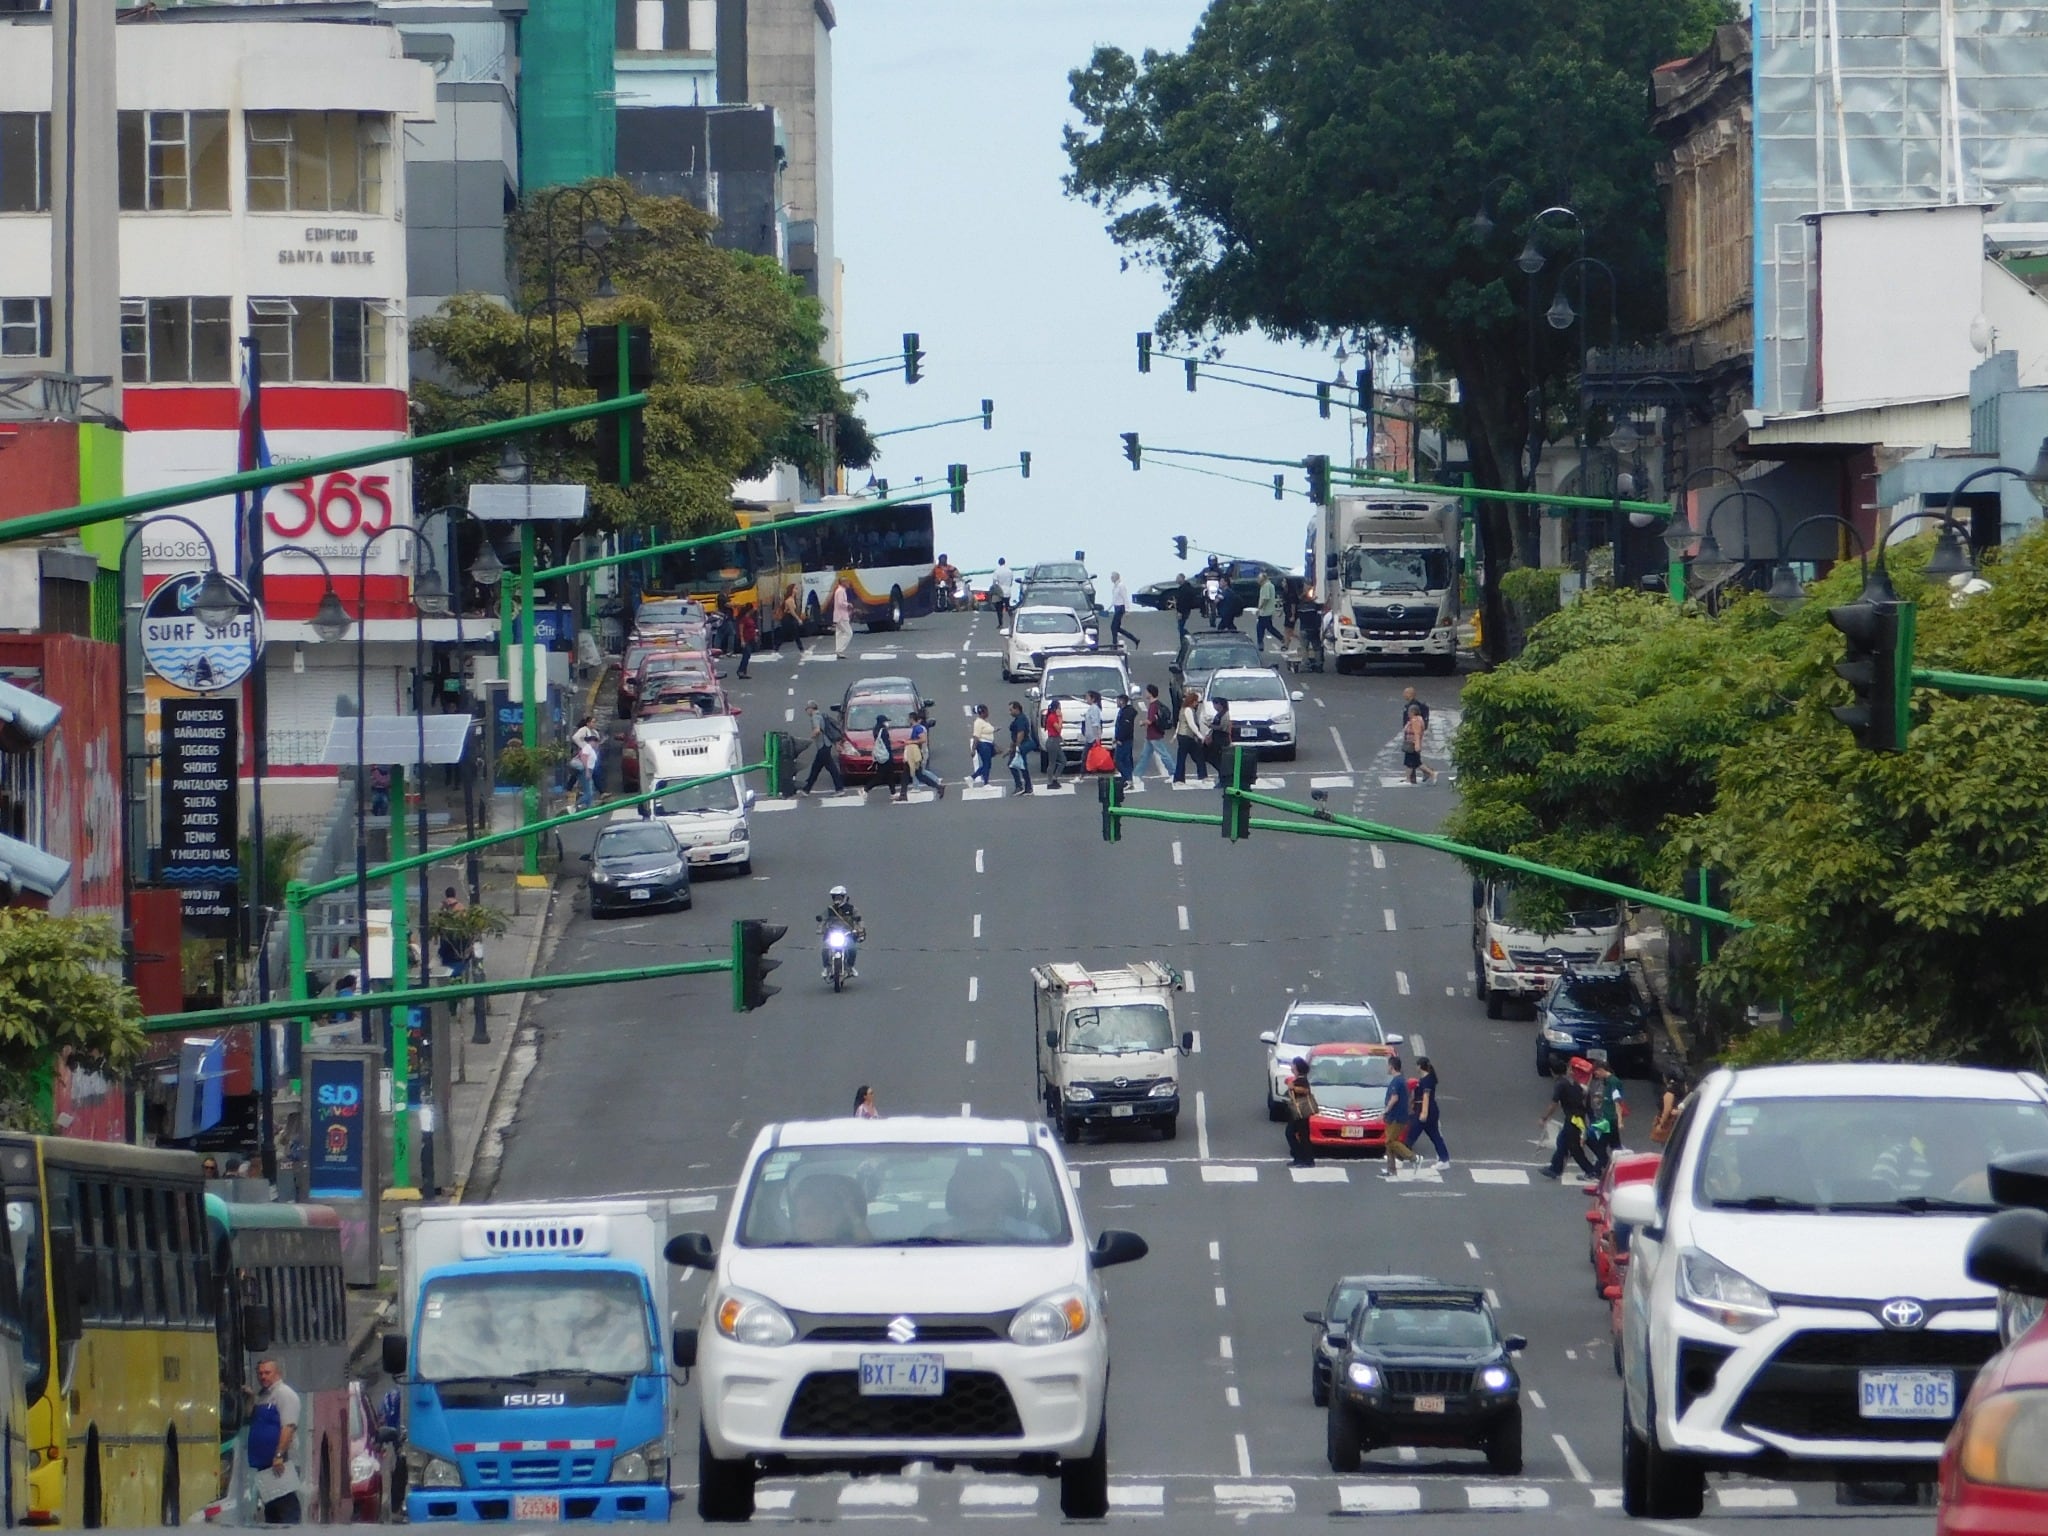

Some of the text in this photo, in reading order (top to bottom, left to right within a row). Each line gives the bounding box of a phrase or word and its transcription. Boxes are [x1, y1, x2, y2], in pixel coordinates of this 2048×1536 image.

[305, 227, 358, 241] EDIFICIO
[278, 250, 323, 264] SANTA
[265, 470, 392, 538] 365
[148, 622, 252, 642] SURF SHOP
[176, 710, 224, 721] CAMISETAS
[174, 726, 226, 739] BAÑADORES
[180, 744, 220, 757] JOGGERS
[183, 762, 217, 774] SHORTS
[172, 779, 229, 791] PANTALONES
[183, 796, 217, 808] SUETAS
[182, 813, 219, 826] JACKETS
[184, 831, 217, 844] TENNIS
[170, 849, 178, 860] Y
[178, 849, 210, 860] MUCHO
[863, 1363, 940, 1385] BXT-473
[504, 1393, 565, 1407] ISUZU
[1864, 1382, 1949, 1406] BVX-885
